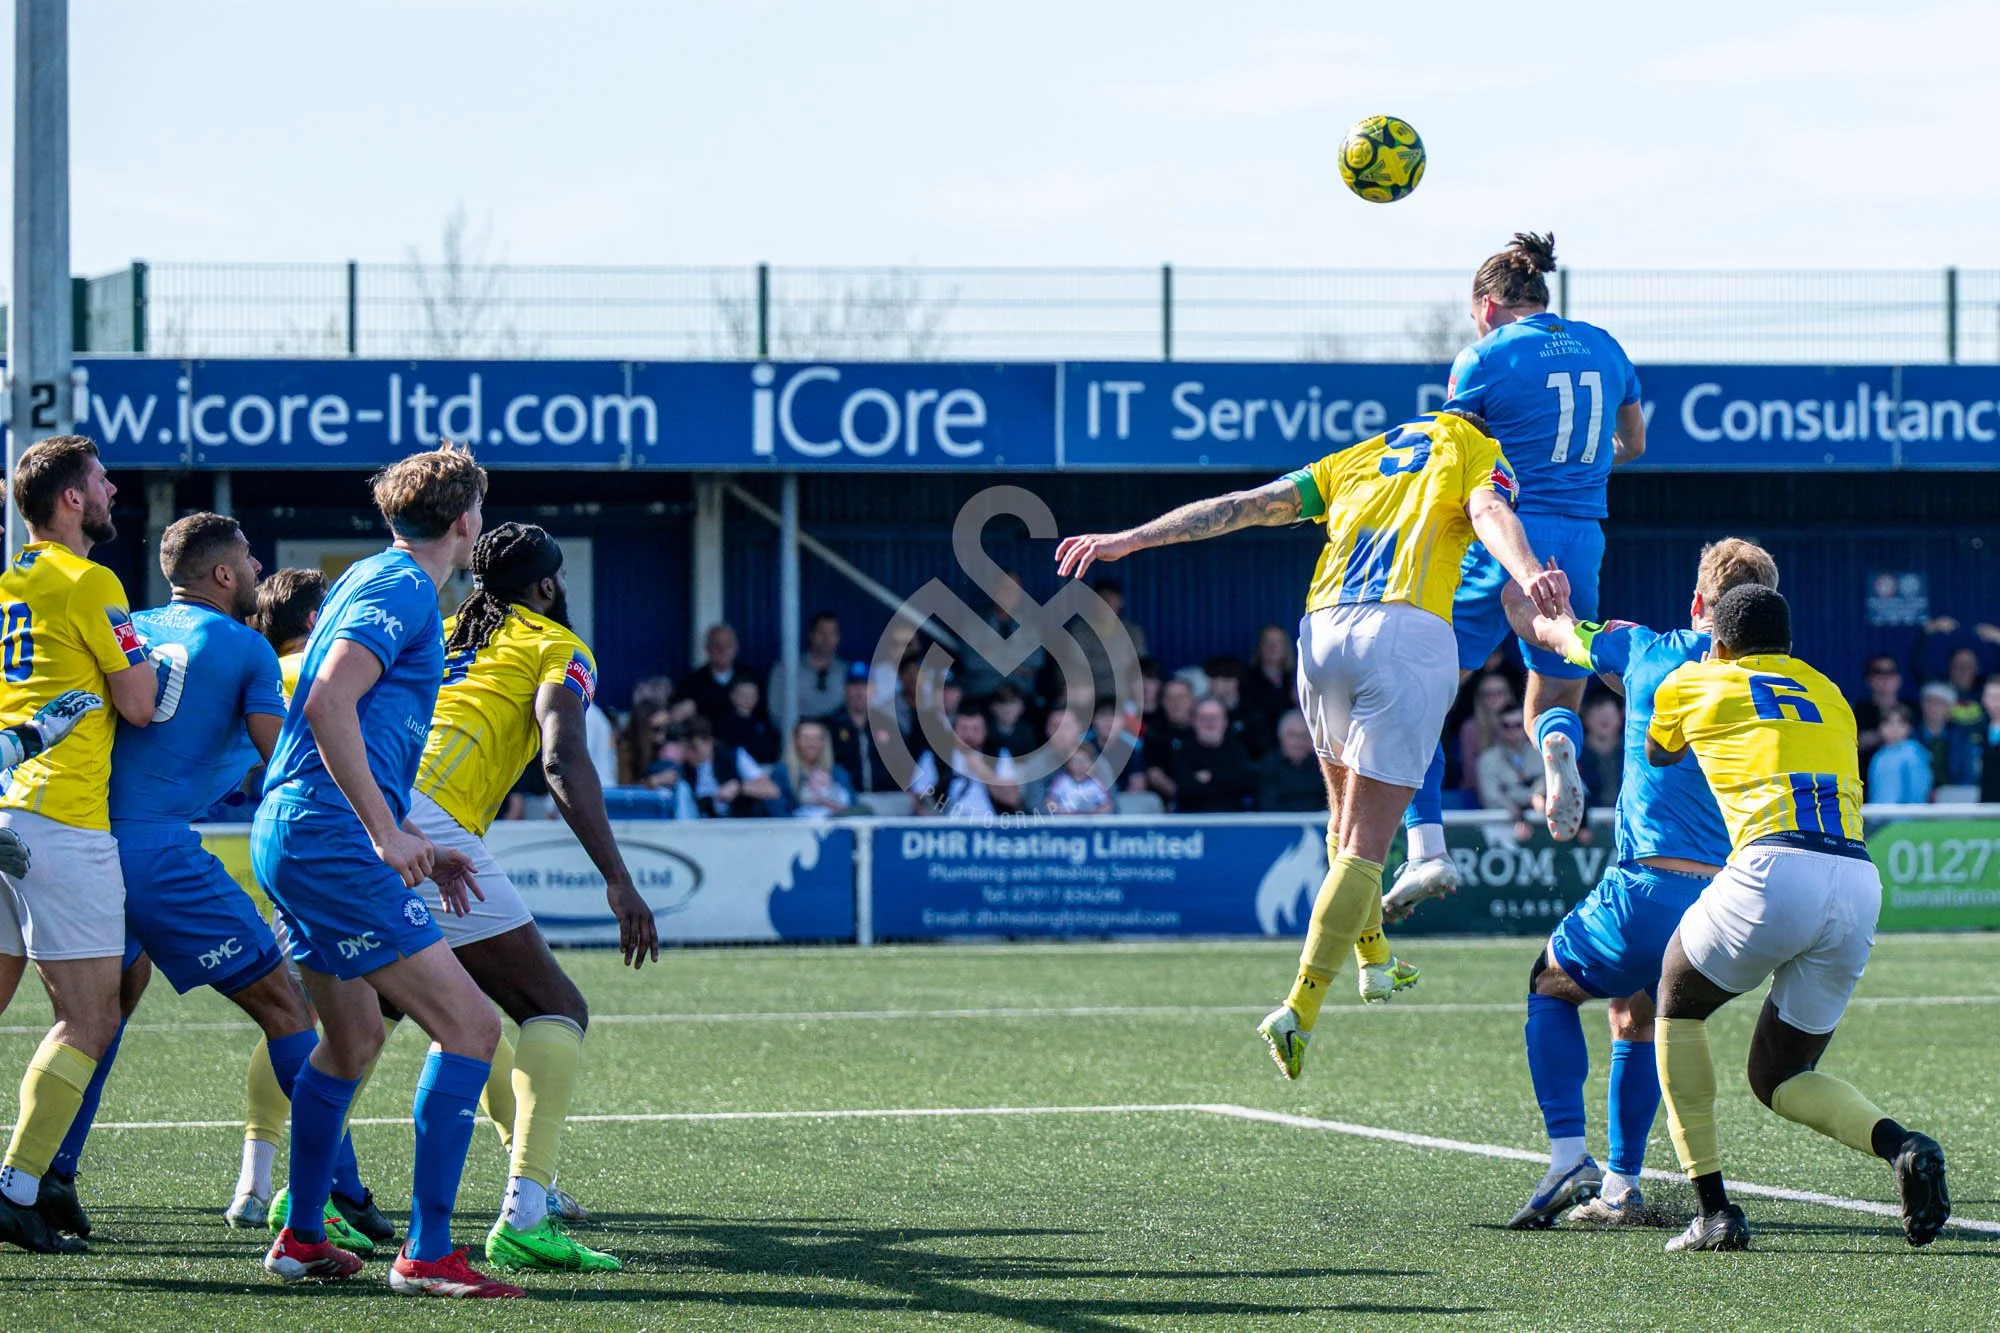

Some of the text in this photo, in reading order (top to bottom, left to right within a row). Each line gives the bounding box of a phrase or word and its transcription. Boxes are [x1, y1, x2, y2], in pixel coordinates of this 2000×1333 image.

[1544, 339, 1582, 349] CROWN
[30, 383, 56, 429] 2
[751, 362, 987, 458] iCore
[1086, 380, 1145, 441] IT
[1170, 382, 1387, 443] Service
[1545, 370, 1602, 464] 11
[1681, 382, 2000, 443] Consultanc
[0, 603, 34, 682] 0
[902, 830, 1205, 865] DHR Heating Limited
[197, 937, 244, 969] DMC
[336, 930, 382, 960] DMC
